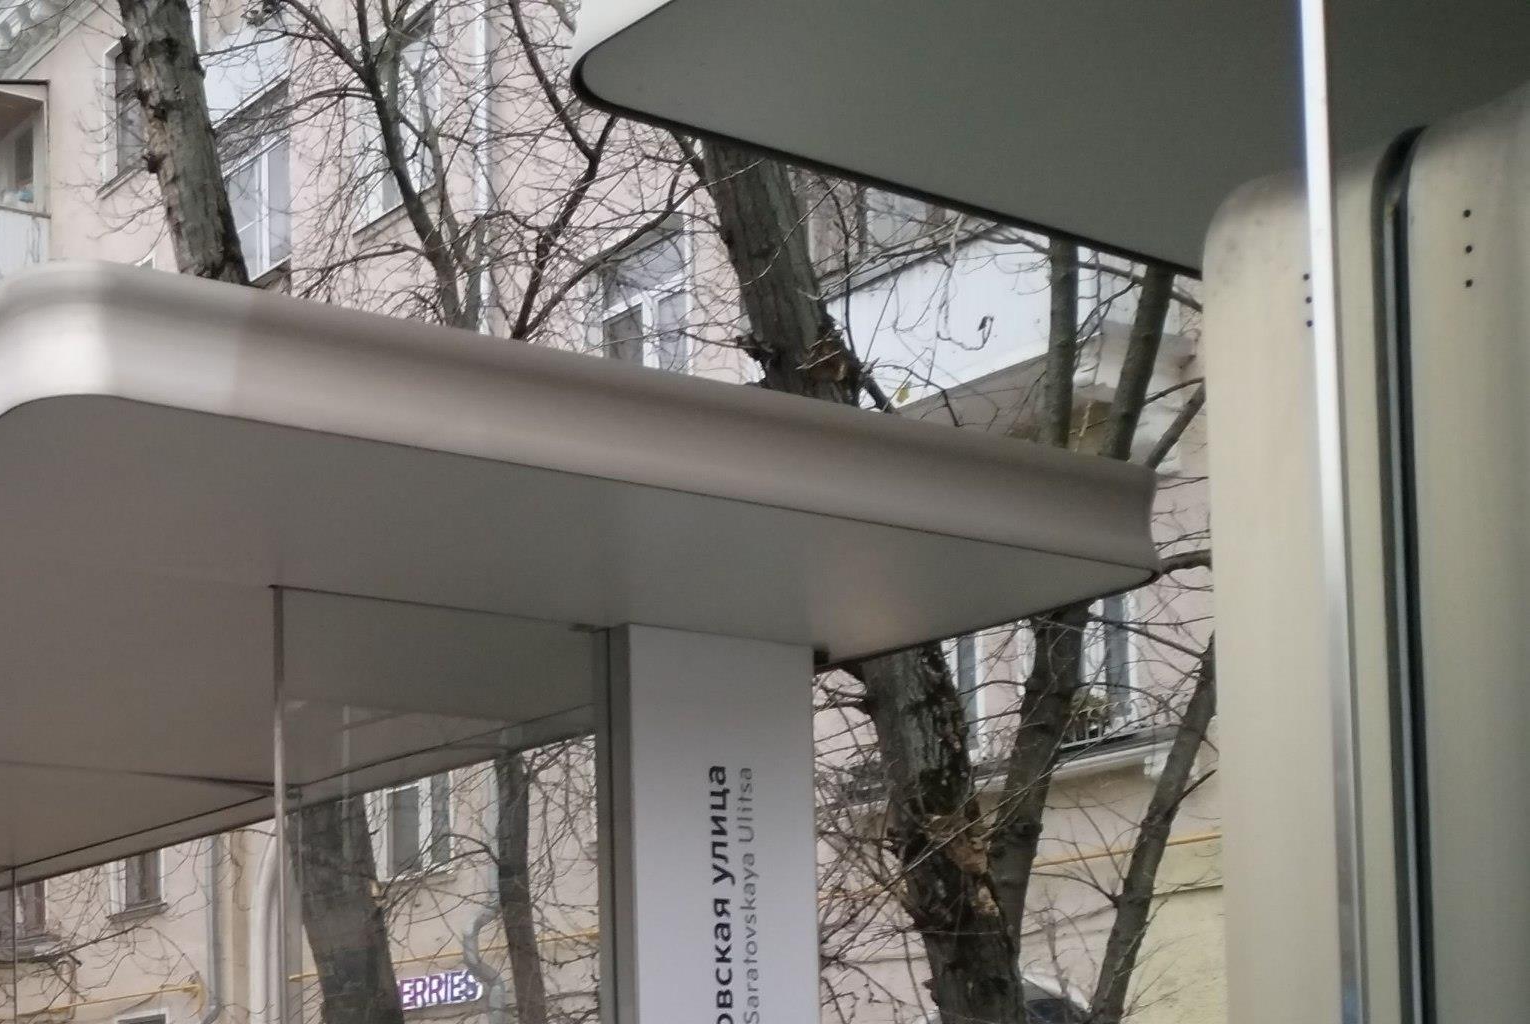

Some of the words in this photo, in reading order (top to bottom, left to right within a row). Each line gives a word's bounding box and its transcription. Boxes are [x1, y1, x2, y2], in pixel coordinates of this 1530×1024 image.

[707, 764, 736, 885] улица
[737, 766, 755, 844] Ulitsa
[398, 970, 479, 1008] ERRIES
